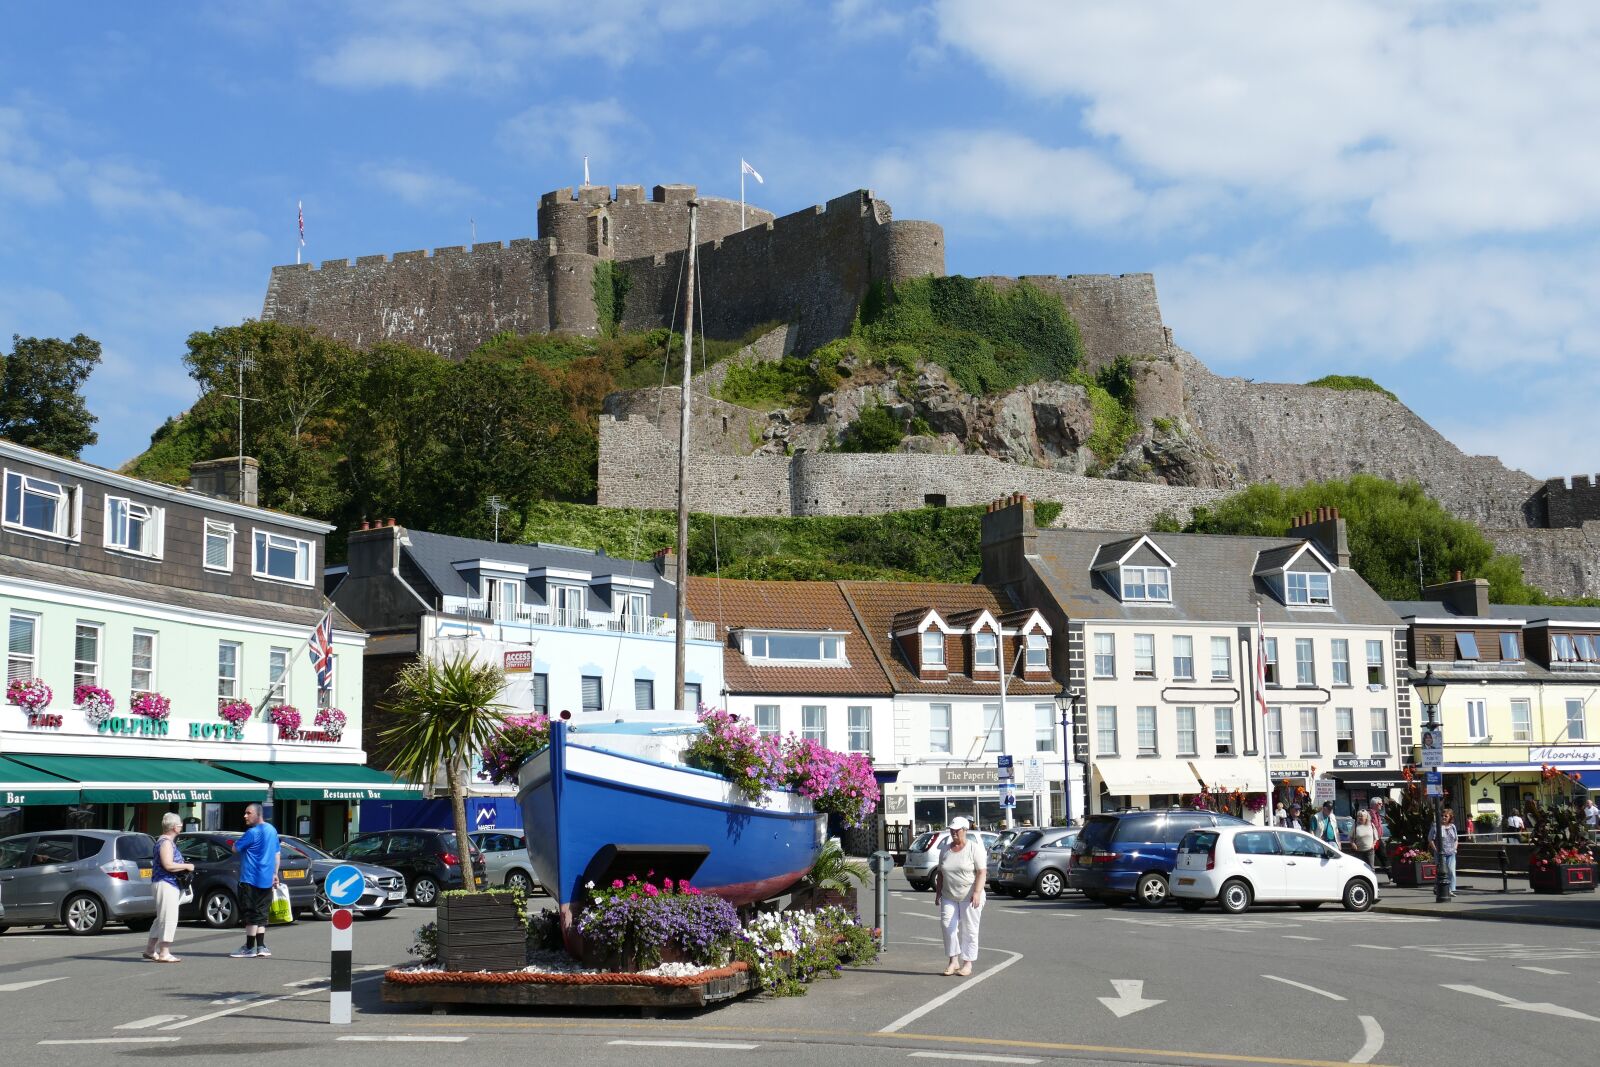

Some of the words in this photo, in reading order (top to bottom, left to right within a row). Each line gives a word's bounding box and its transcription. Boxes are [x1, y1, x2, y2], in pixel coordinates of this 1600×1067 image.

[507, 653, 530, 661] ACCESS
[99, 717, 168, 735] DOLPHIN
[1534, 748, 1597, 762] Moorings
[946, 771, 961, 780] The
[963, 771, 985, 782] Paper
[986, 771, 999, 781] Fig
[6, 792, 26, 804] Bar
[152, 789, 186, 803] Dolphin
[190, 790, 213, 801] Hotel
[323, 789, 365, 799] Restaurant
[367, 789, 381, 799] Bar
